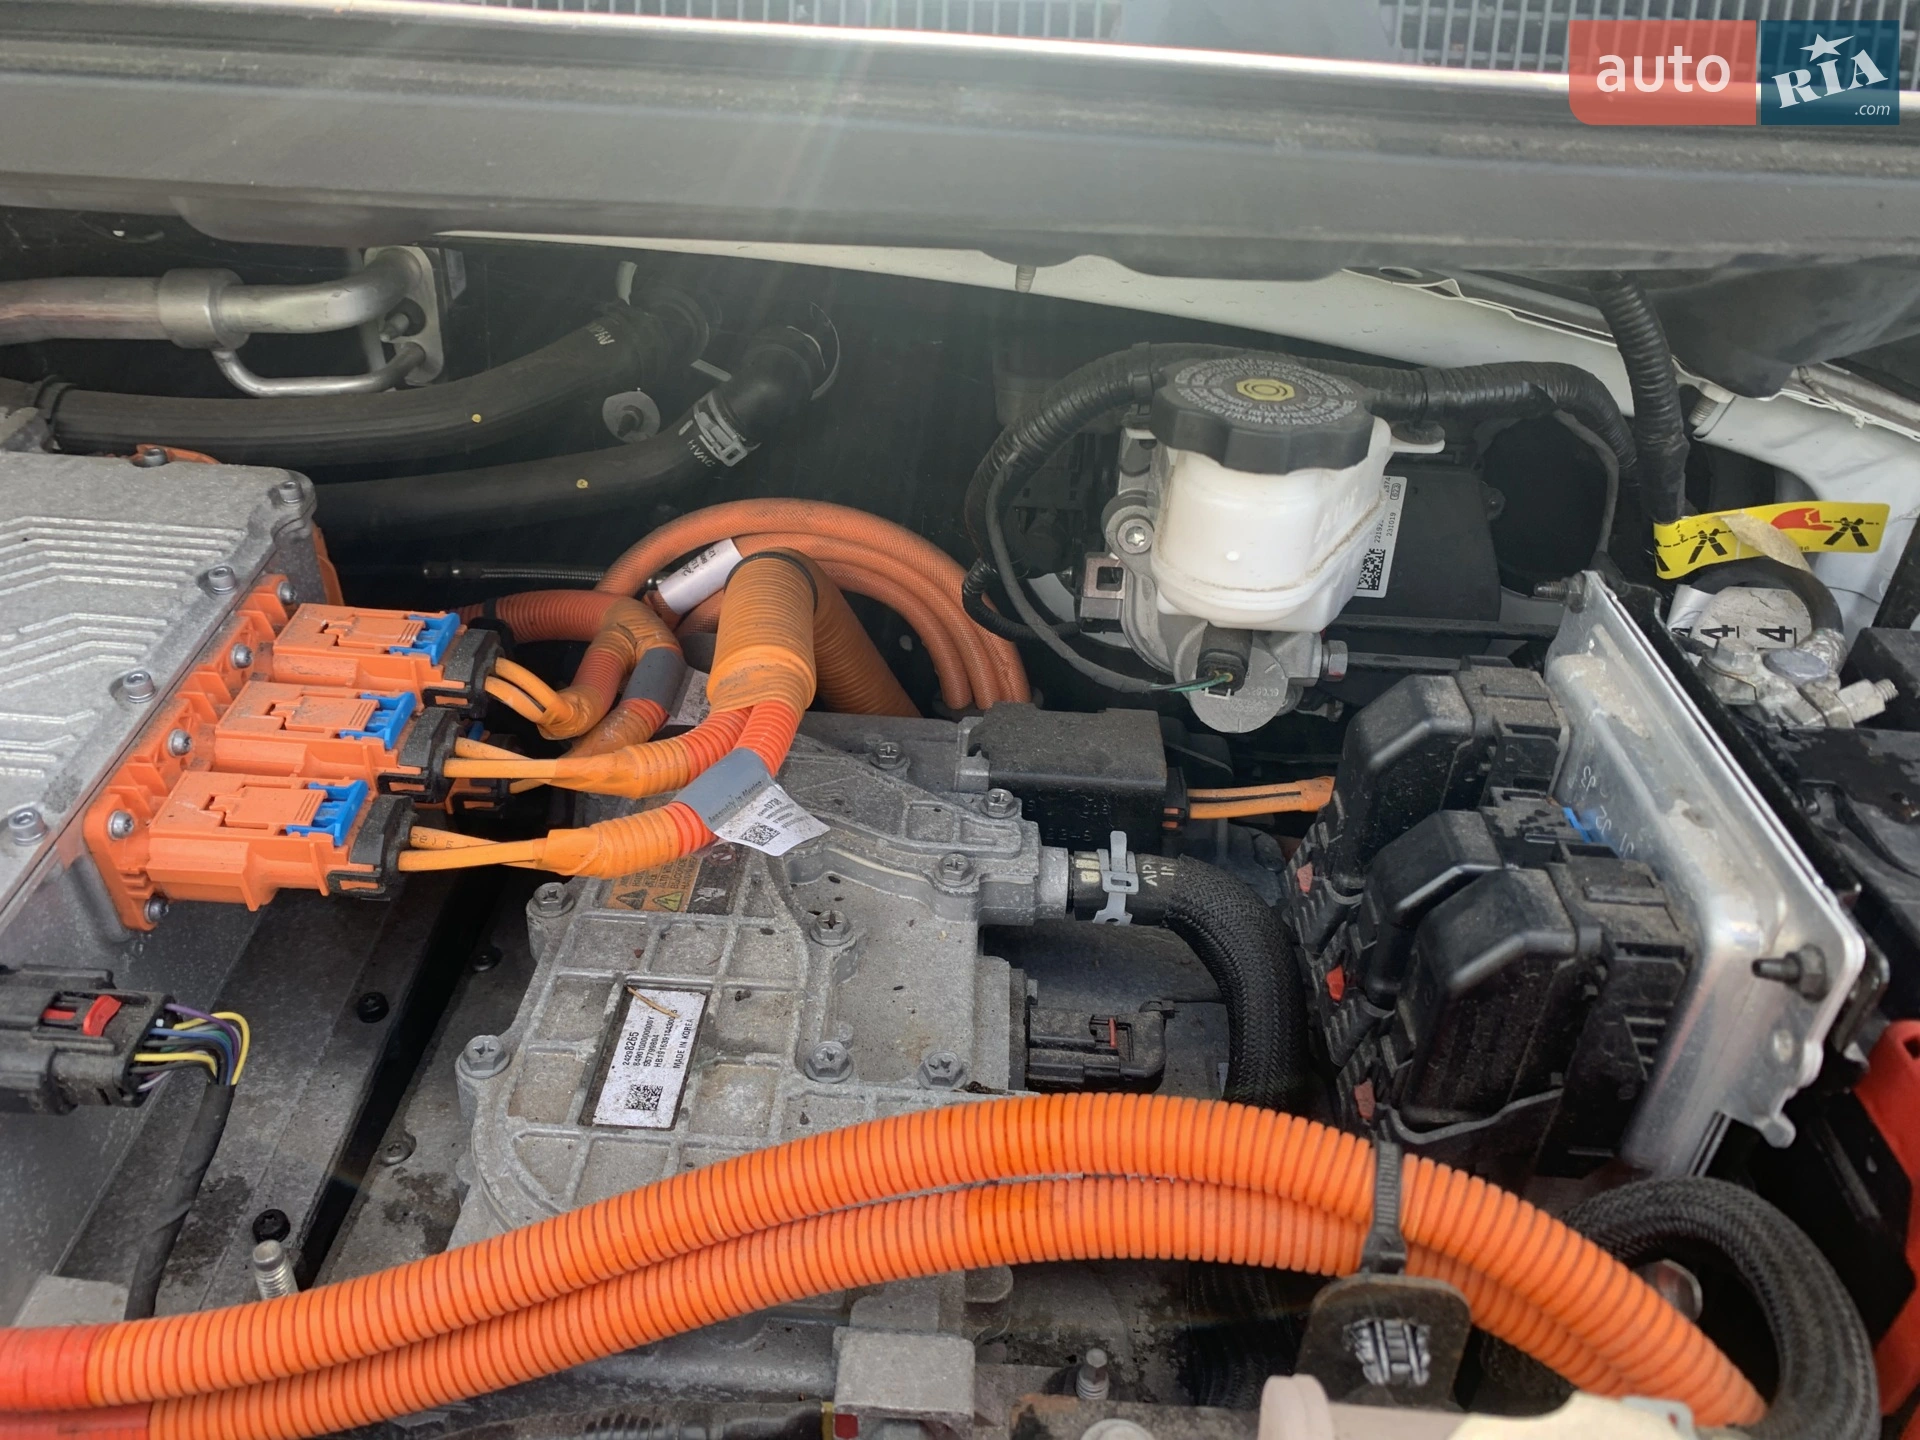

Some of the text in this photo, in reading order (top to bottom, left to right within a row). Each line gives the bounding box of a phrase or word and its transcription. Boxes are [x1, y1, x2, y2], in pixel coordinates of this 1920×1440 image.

[687, 439, 715, 467] HVAC
[1386, 512, 1396, 537] 231019
[622, 1031, 639, 1066] 24298265
[673, 1018, 694, 1069] MADE IN KOREA
